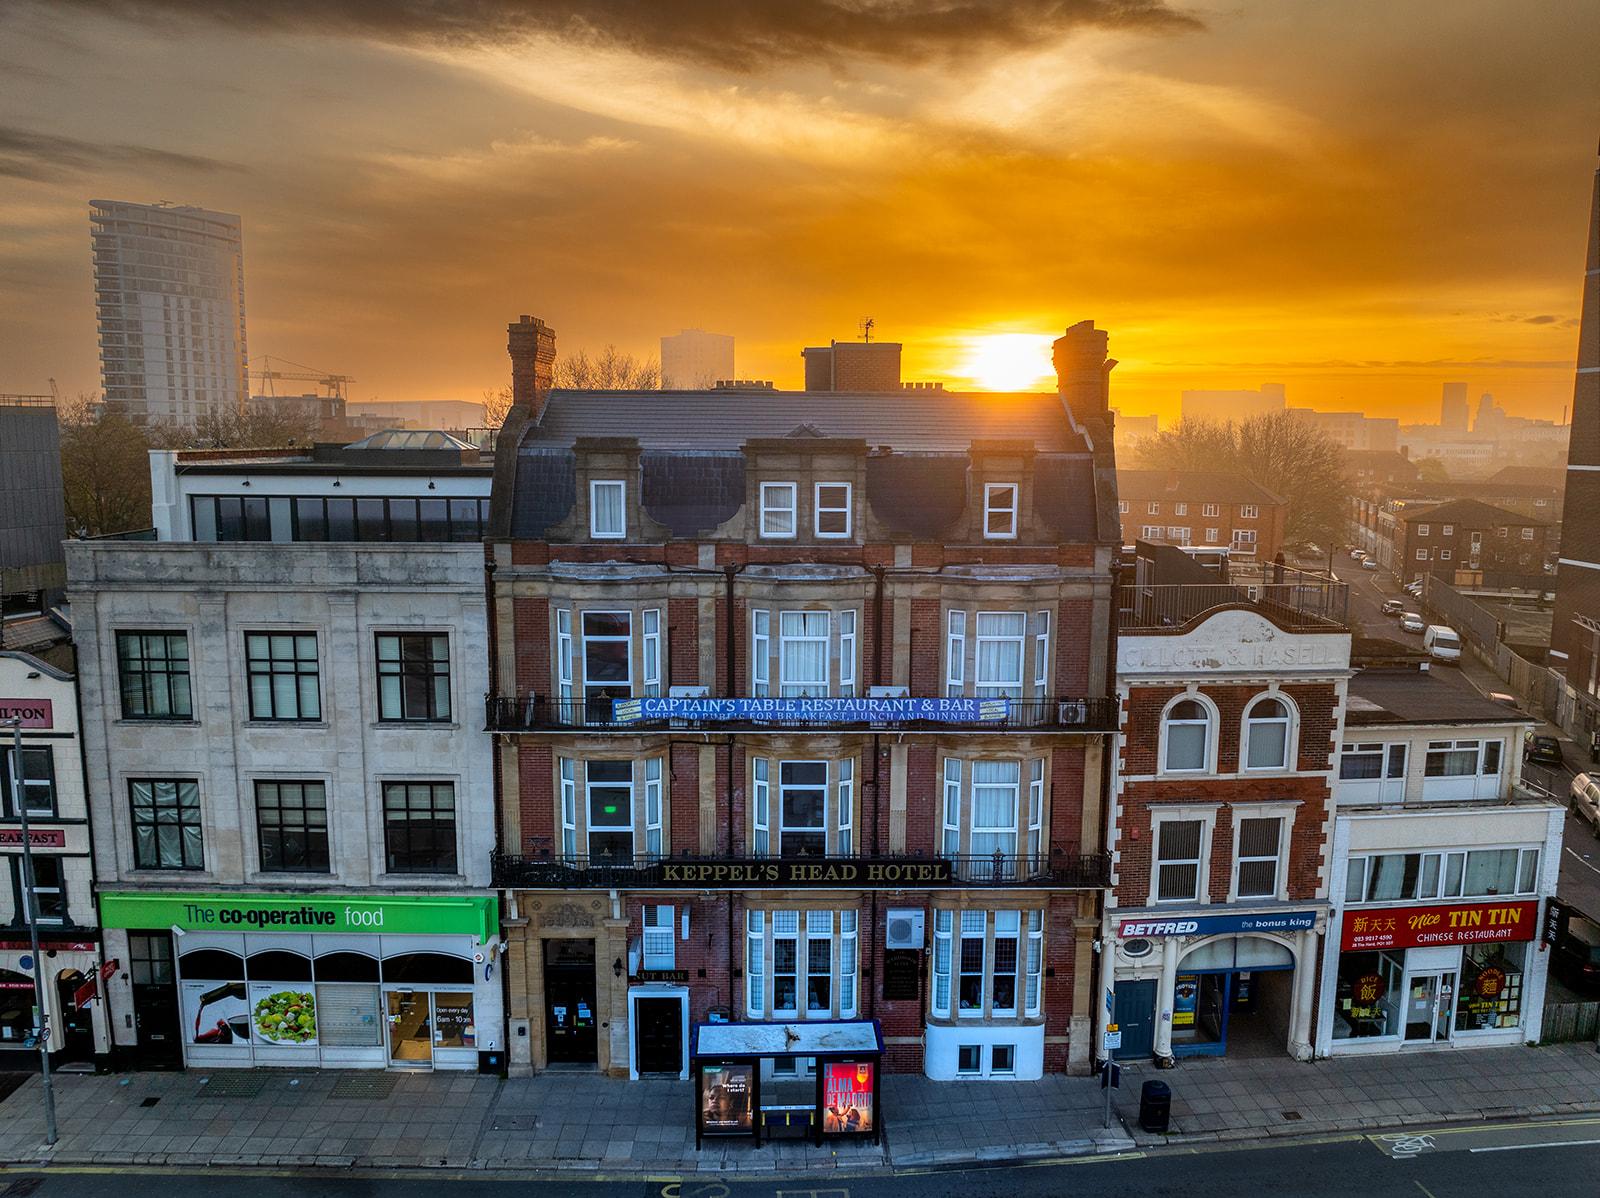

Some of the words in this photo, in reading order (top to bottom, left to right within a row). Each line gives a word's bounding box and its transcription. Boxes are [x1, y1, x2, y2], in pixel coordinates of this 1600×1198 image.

[645, 699, 735, 712] CAPTAIN'S
[739, 699, 796, 712] TABLE
[801, 699, 918, 712] RESTAURANT
[921, 699, 935, 711] &
[939, 699, 976, 712] BAR
[682, 712, 698, 720] TO
[749, 712, 773, 720] FOR
[777, 712, 850, 721] BREAKFAST,
[853, 712, 894, 720] LUNCH
[898, 712, 925, 720] AND
[928, 712, 975, 720] DINNER
[663, 865, 779, 881] KEPPEL'S
[790, 865, 858, 881] HEAD
[867, 865, 947, 881] HOTEL
[184, 904, 215, 924] The
[219, 907, 336, 928] co-operative
[344, 906, 384, 926] food
[1241, 921, 1254, 929] the
[1255, 918, 1287, 928] bonus
[1289, 917, 1312, 929] king
[1408, 913, 1440, 930] Nice
[1449, 910, 1483, 928] TIN
[1487, 908, 1522, 925] TIN
[1122, 921, 1199, 937] BETFRED
[1416, 932, 1454, 943] CHINESE
[1458, 929, 1512, 940] RESTAURANT
[827, 1077, 853, 1092] ALMA
[827, 1092, 836, 1106] DE
[837, 1092, 873, 1108] MADRID
